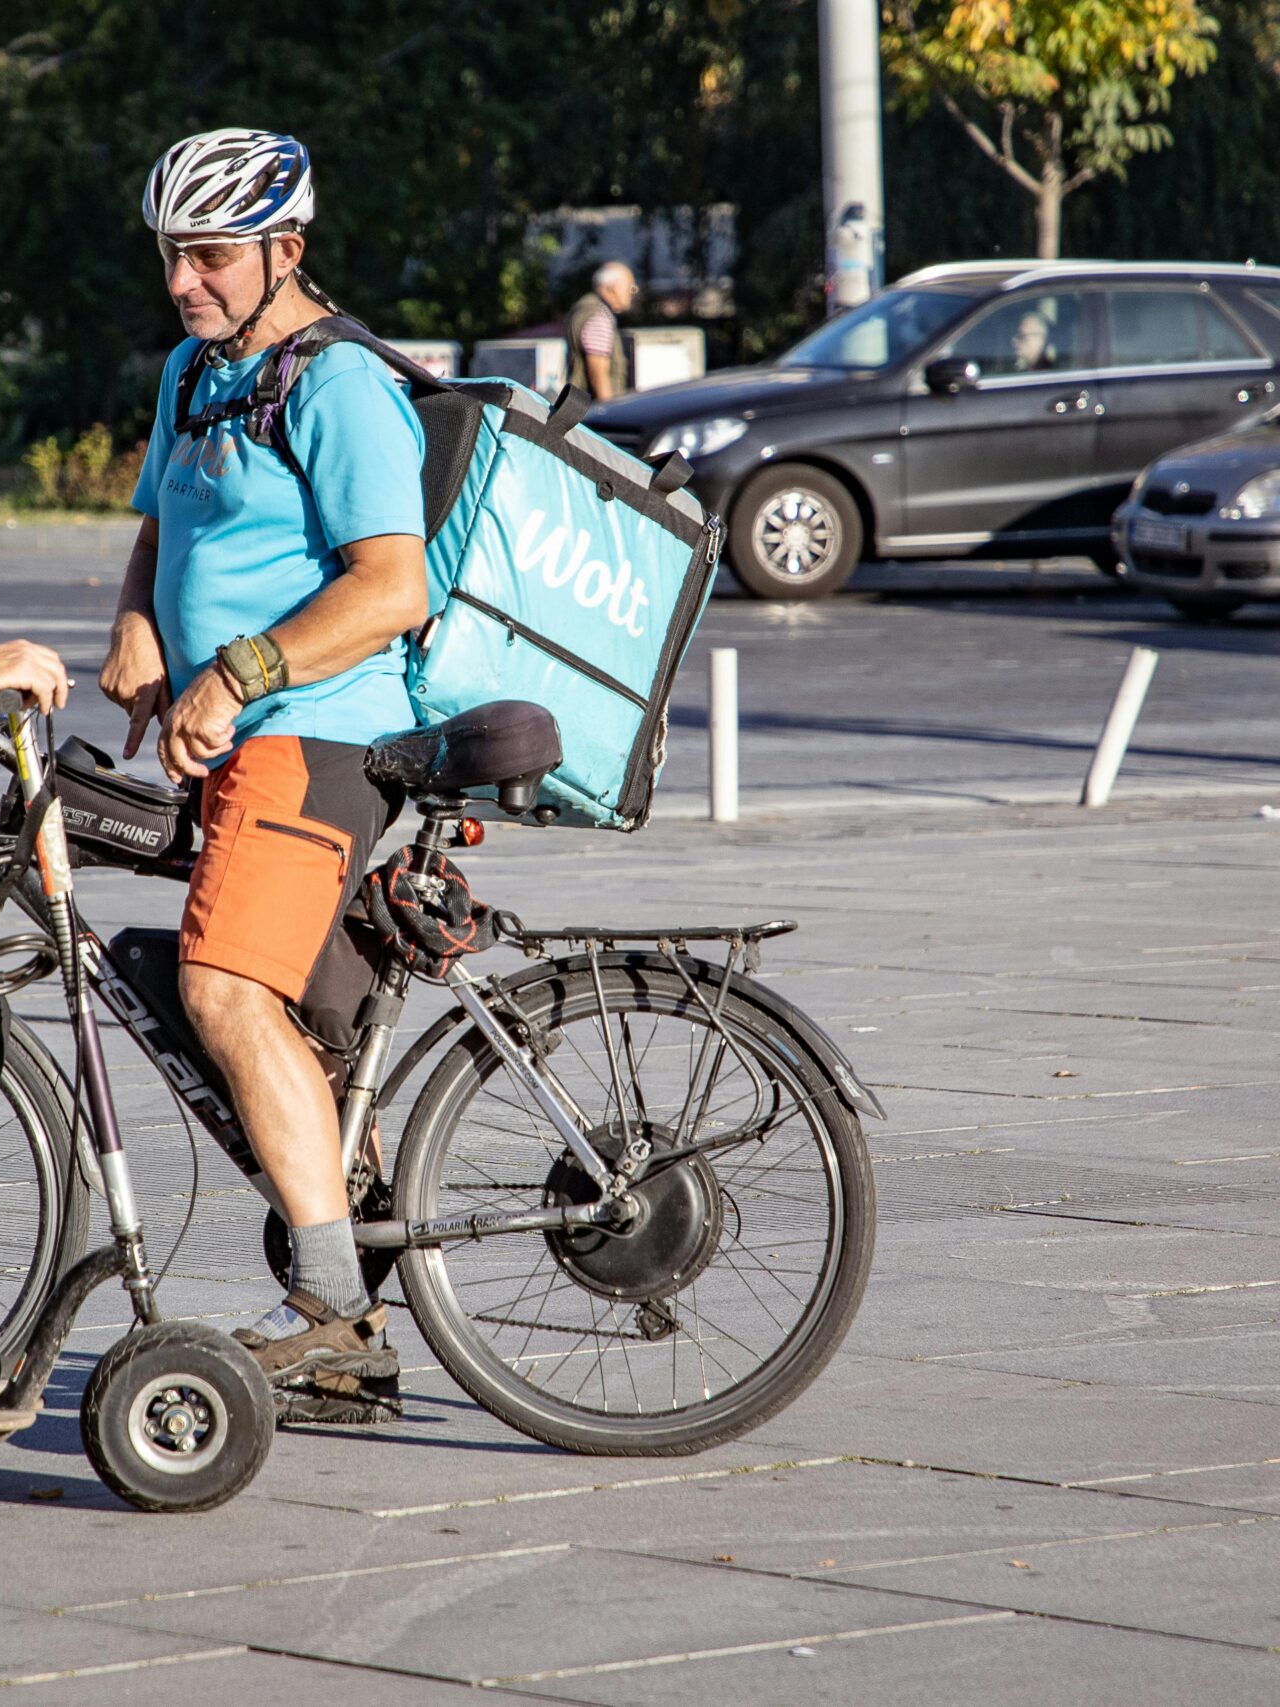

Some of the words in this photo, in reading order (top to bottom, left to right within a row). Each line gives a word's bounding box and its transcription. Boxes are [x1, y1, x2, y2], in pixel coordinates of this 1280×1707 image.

[190, 218, 211, 228] uvex
[167, 479, 211, 502] PARTNER
[516, 509, 650, 638] Wolt
[62, 805, 97, 828] EST
[99, 817, 162, 847] BIKING
